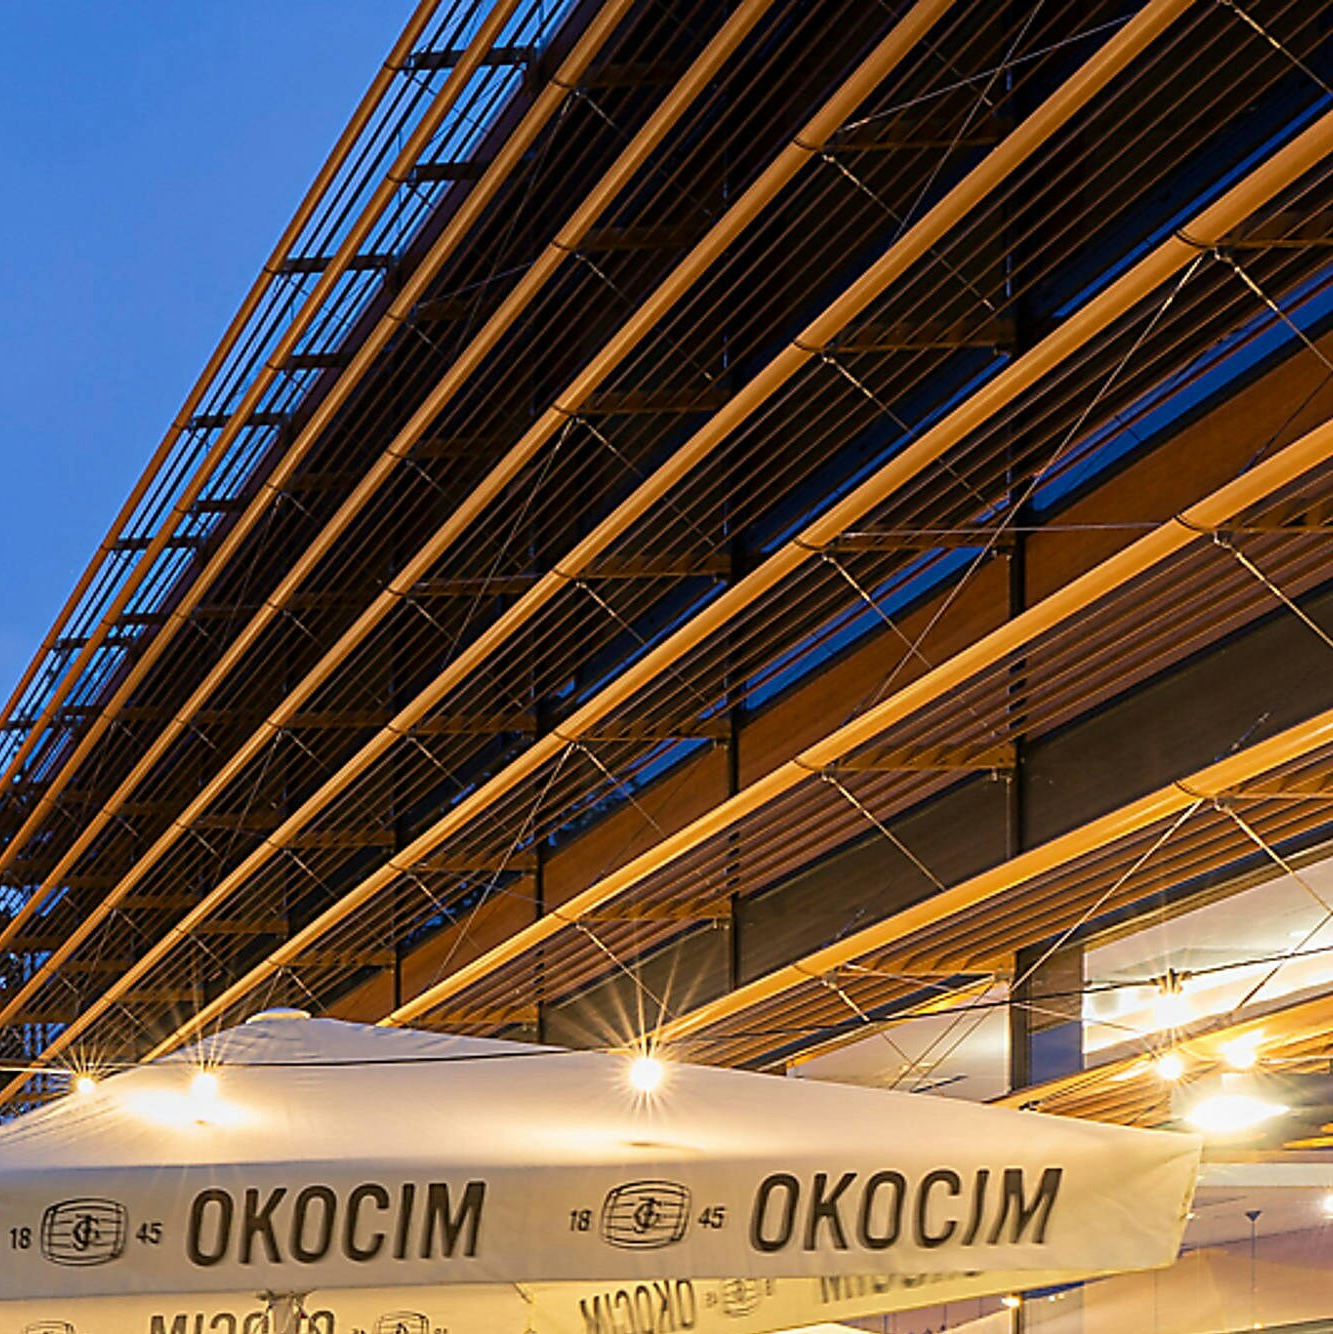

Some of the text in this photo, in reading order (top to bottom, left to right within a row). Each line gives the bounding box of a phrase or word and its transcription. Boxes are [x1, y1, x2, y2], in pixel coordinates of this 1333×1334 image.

[9, 1167, 1063, 1267] 18 45 OKOCIM 18 45 OKOCIM
